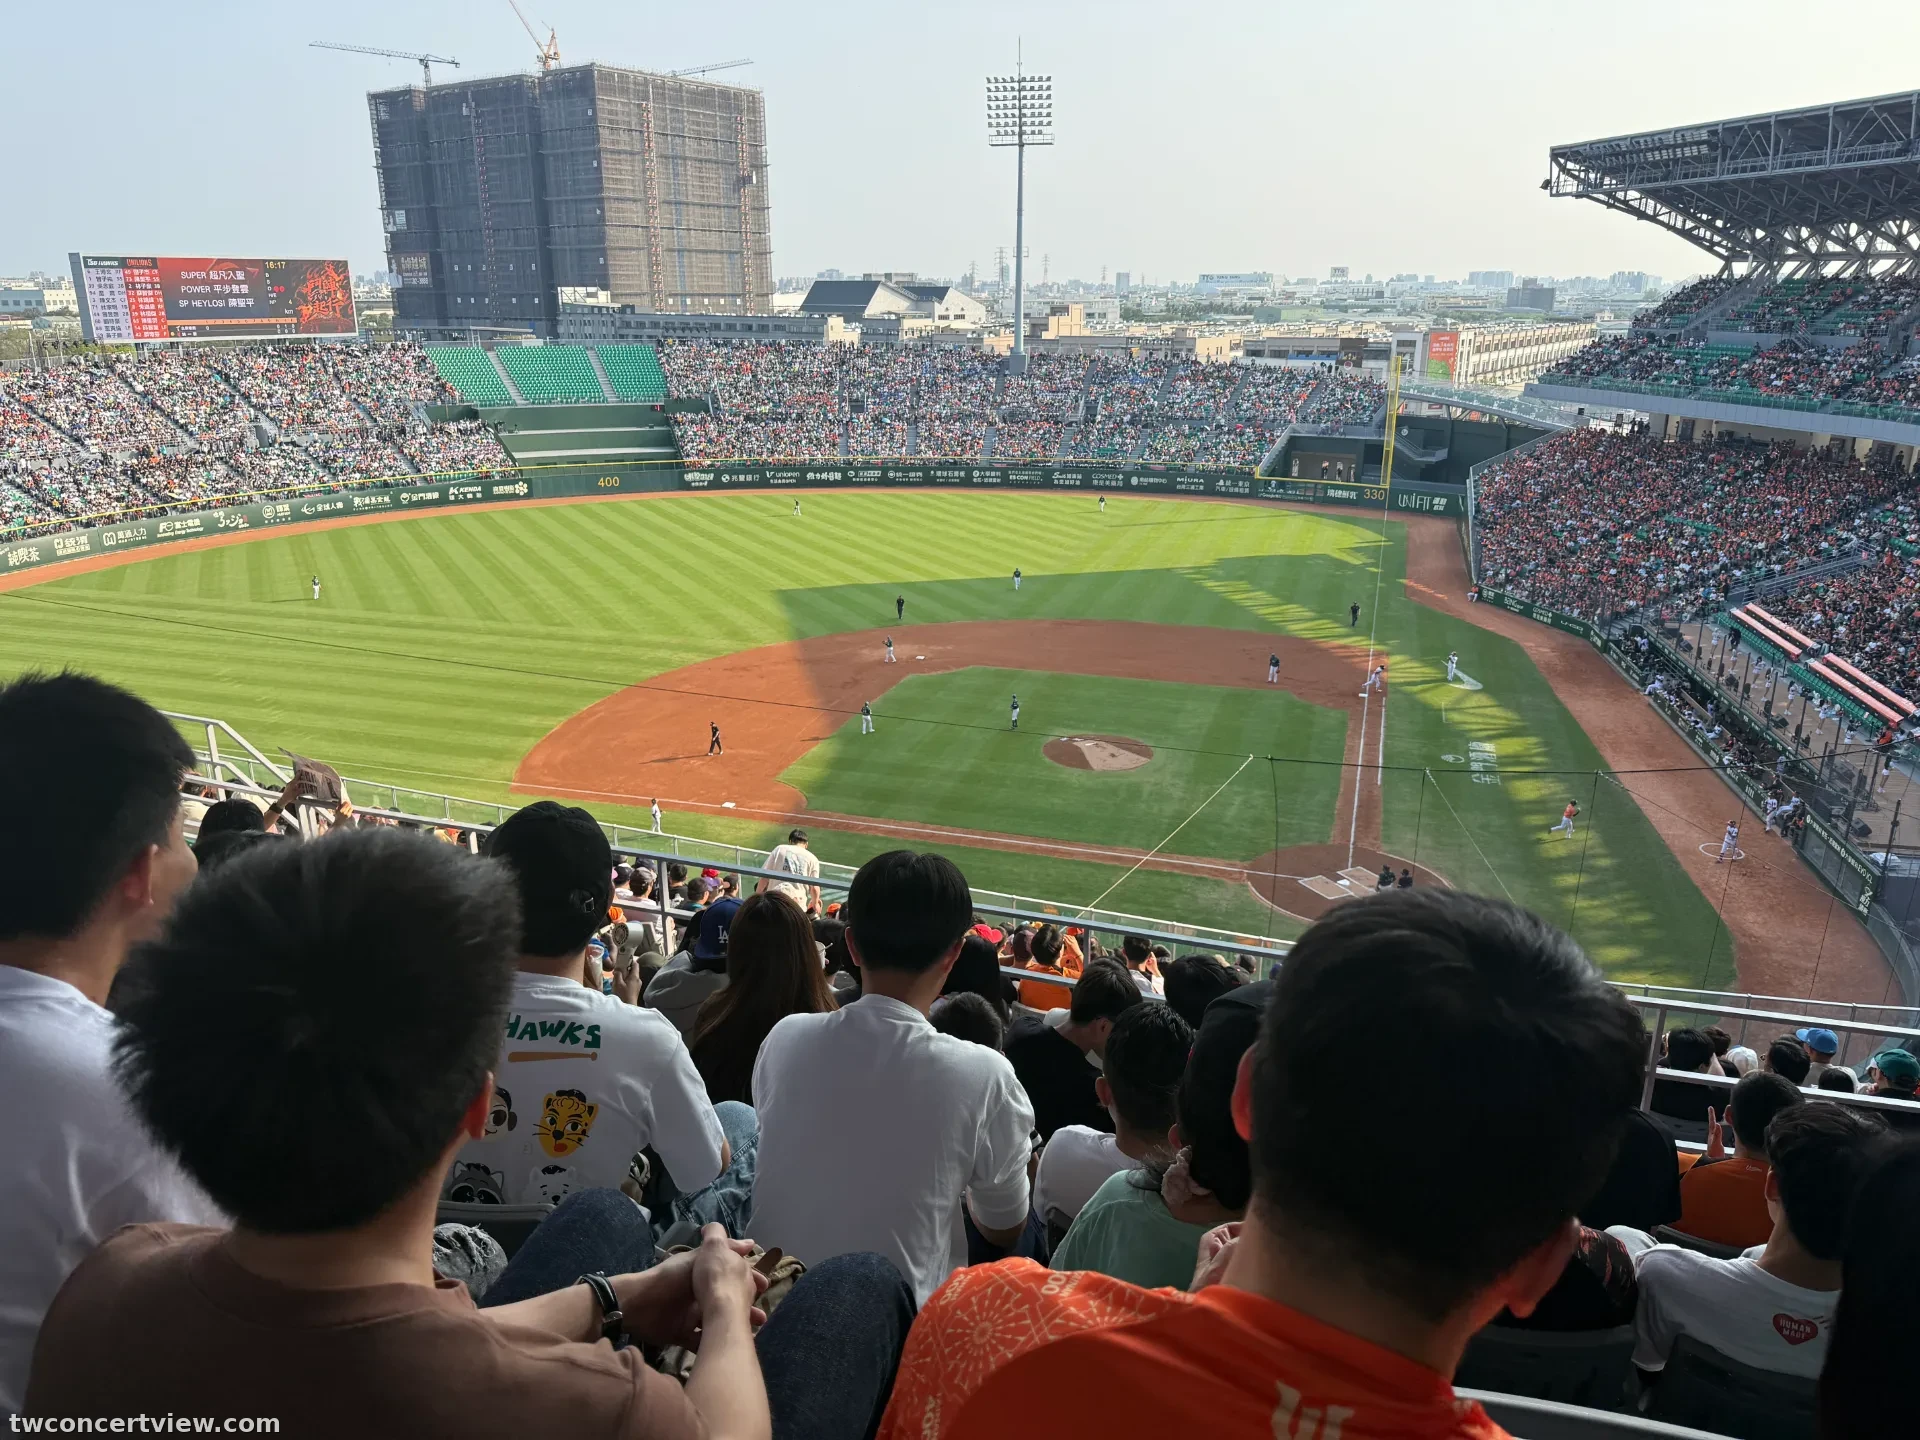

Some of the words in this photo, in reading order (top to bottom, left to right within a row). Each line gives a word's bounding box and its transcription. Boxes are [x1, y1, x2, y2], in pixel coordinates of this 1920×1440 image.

[181, 271, 206, 279] SUPER
[209, 270, 246, 281] 超凡入聖
[181, 285, 211, 293] POWER
[179, 300, 189, 308] SP
[598, 476, 620, 488] 400
[731, 474, 760, 482] 兆豐銀行
[1364, 489, 1385, 500] 330
[8, 546, 41, 567] 純喫茶
[505, 1012, 601, 1049] HAWKS
[1779, 1318, 1811, 1333] HUMAN
[1782, 1329, 1806, 1340] MADE
